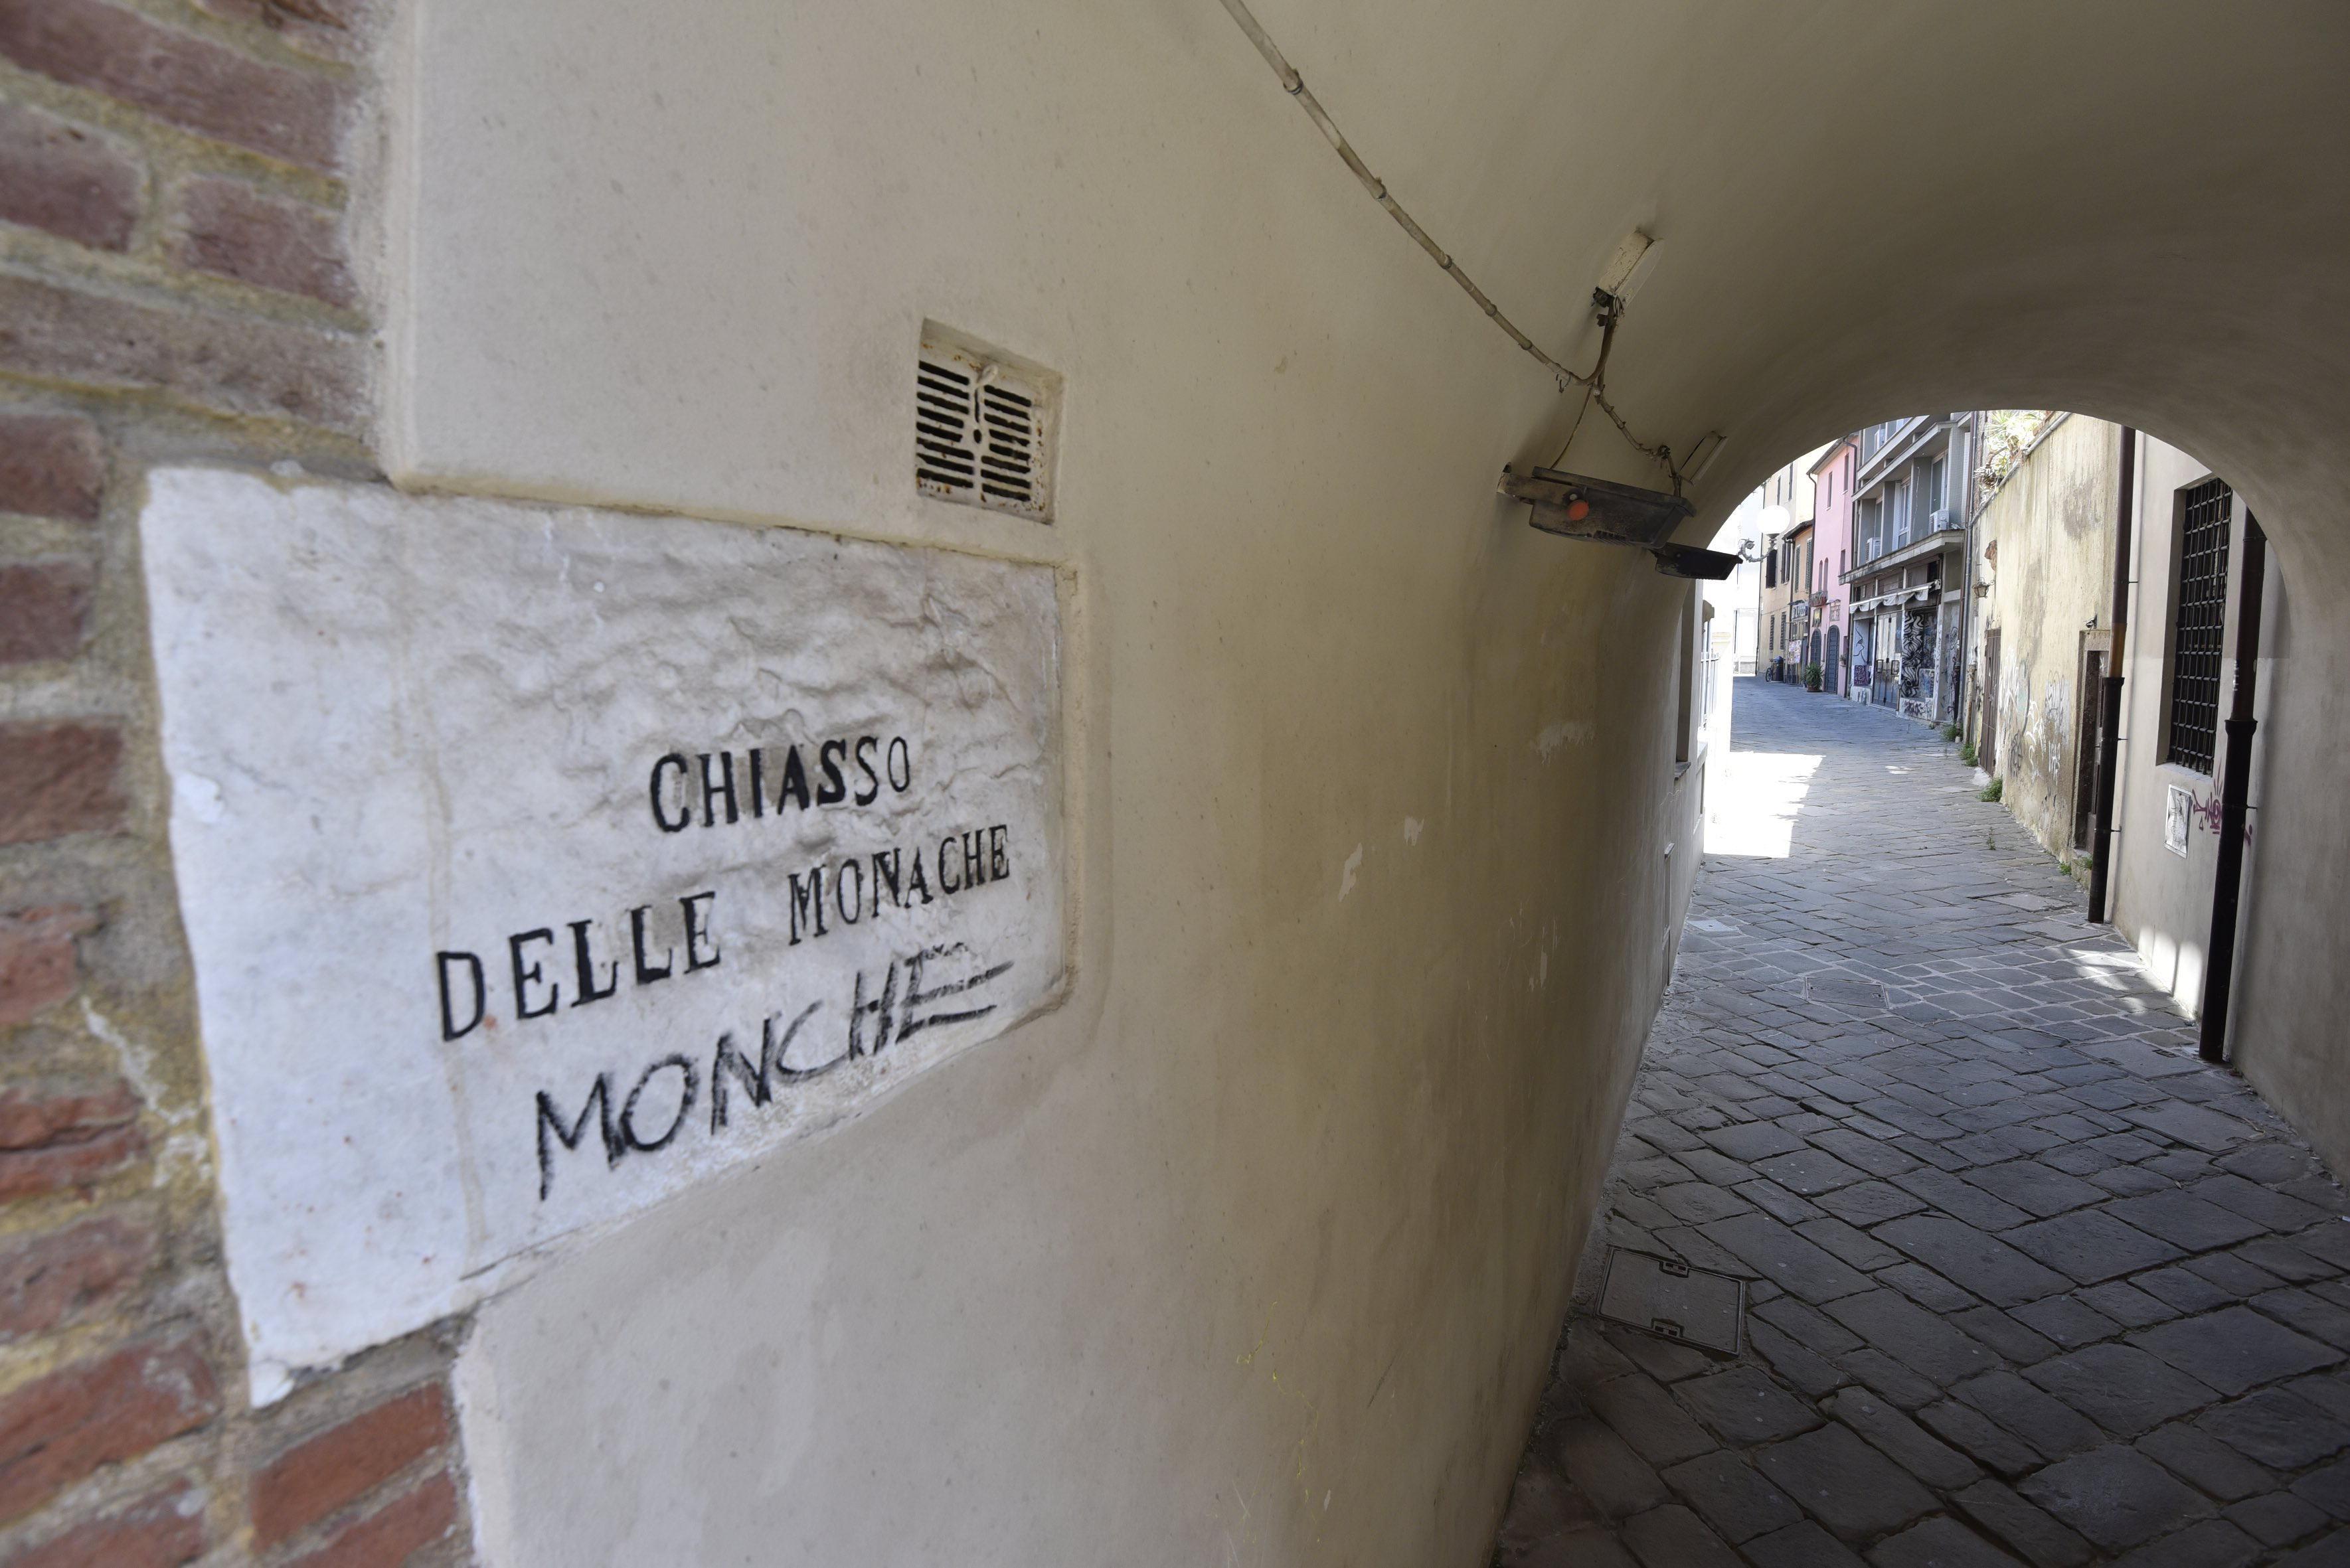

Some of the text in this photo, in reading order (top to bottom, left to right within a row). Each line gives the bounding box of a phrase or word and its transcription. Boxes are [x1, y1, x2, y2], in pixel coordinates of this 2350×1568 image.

[650, 736, 912, 832] CHIASSO
[438, 824, 1011, 1041] DELLE MONACHE
[535, 942, 1015, 1202] MONCHE
